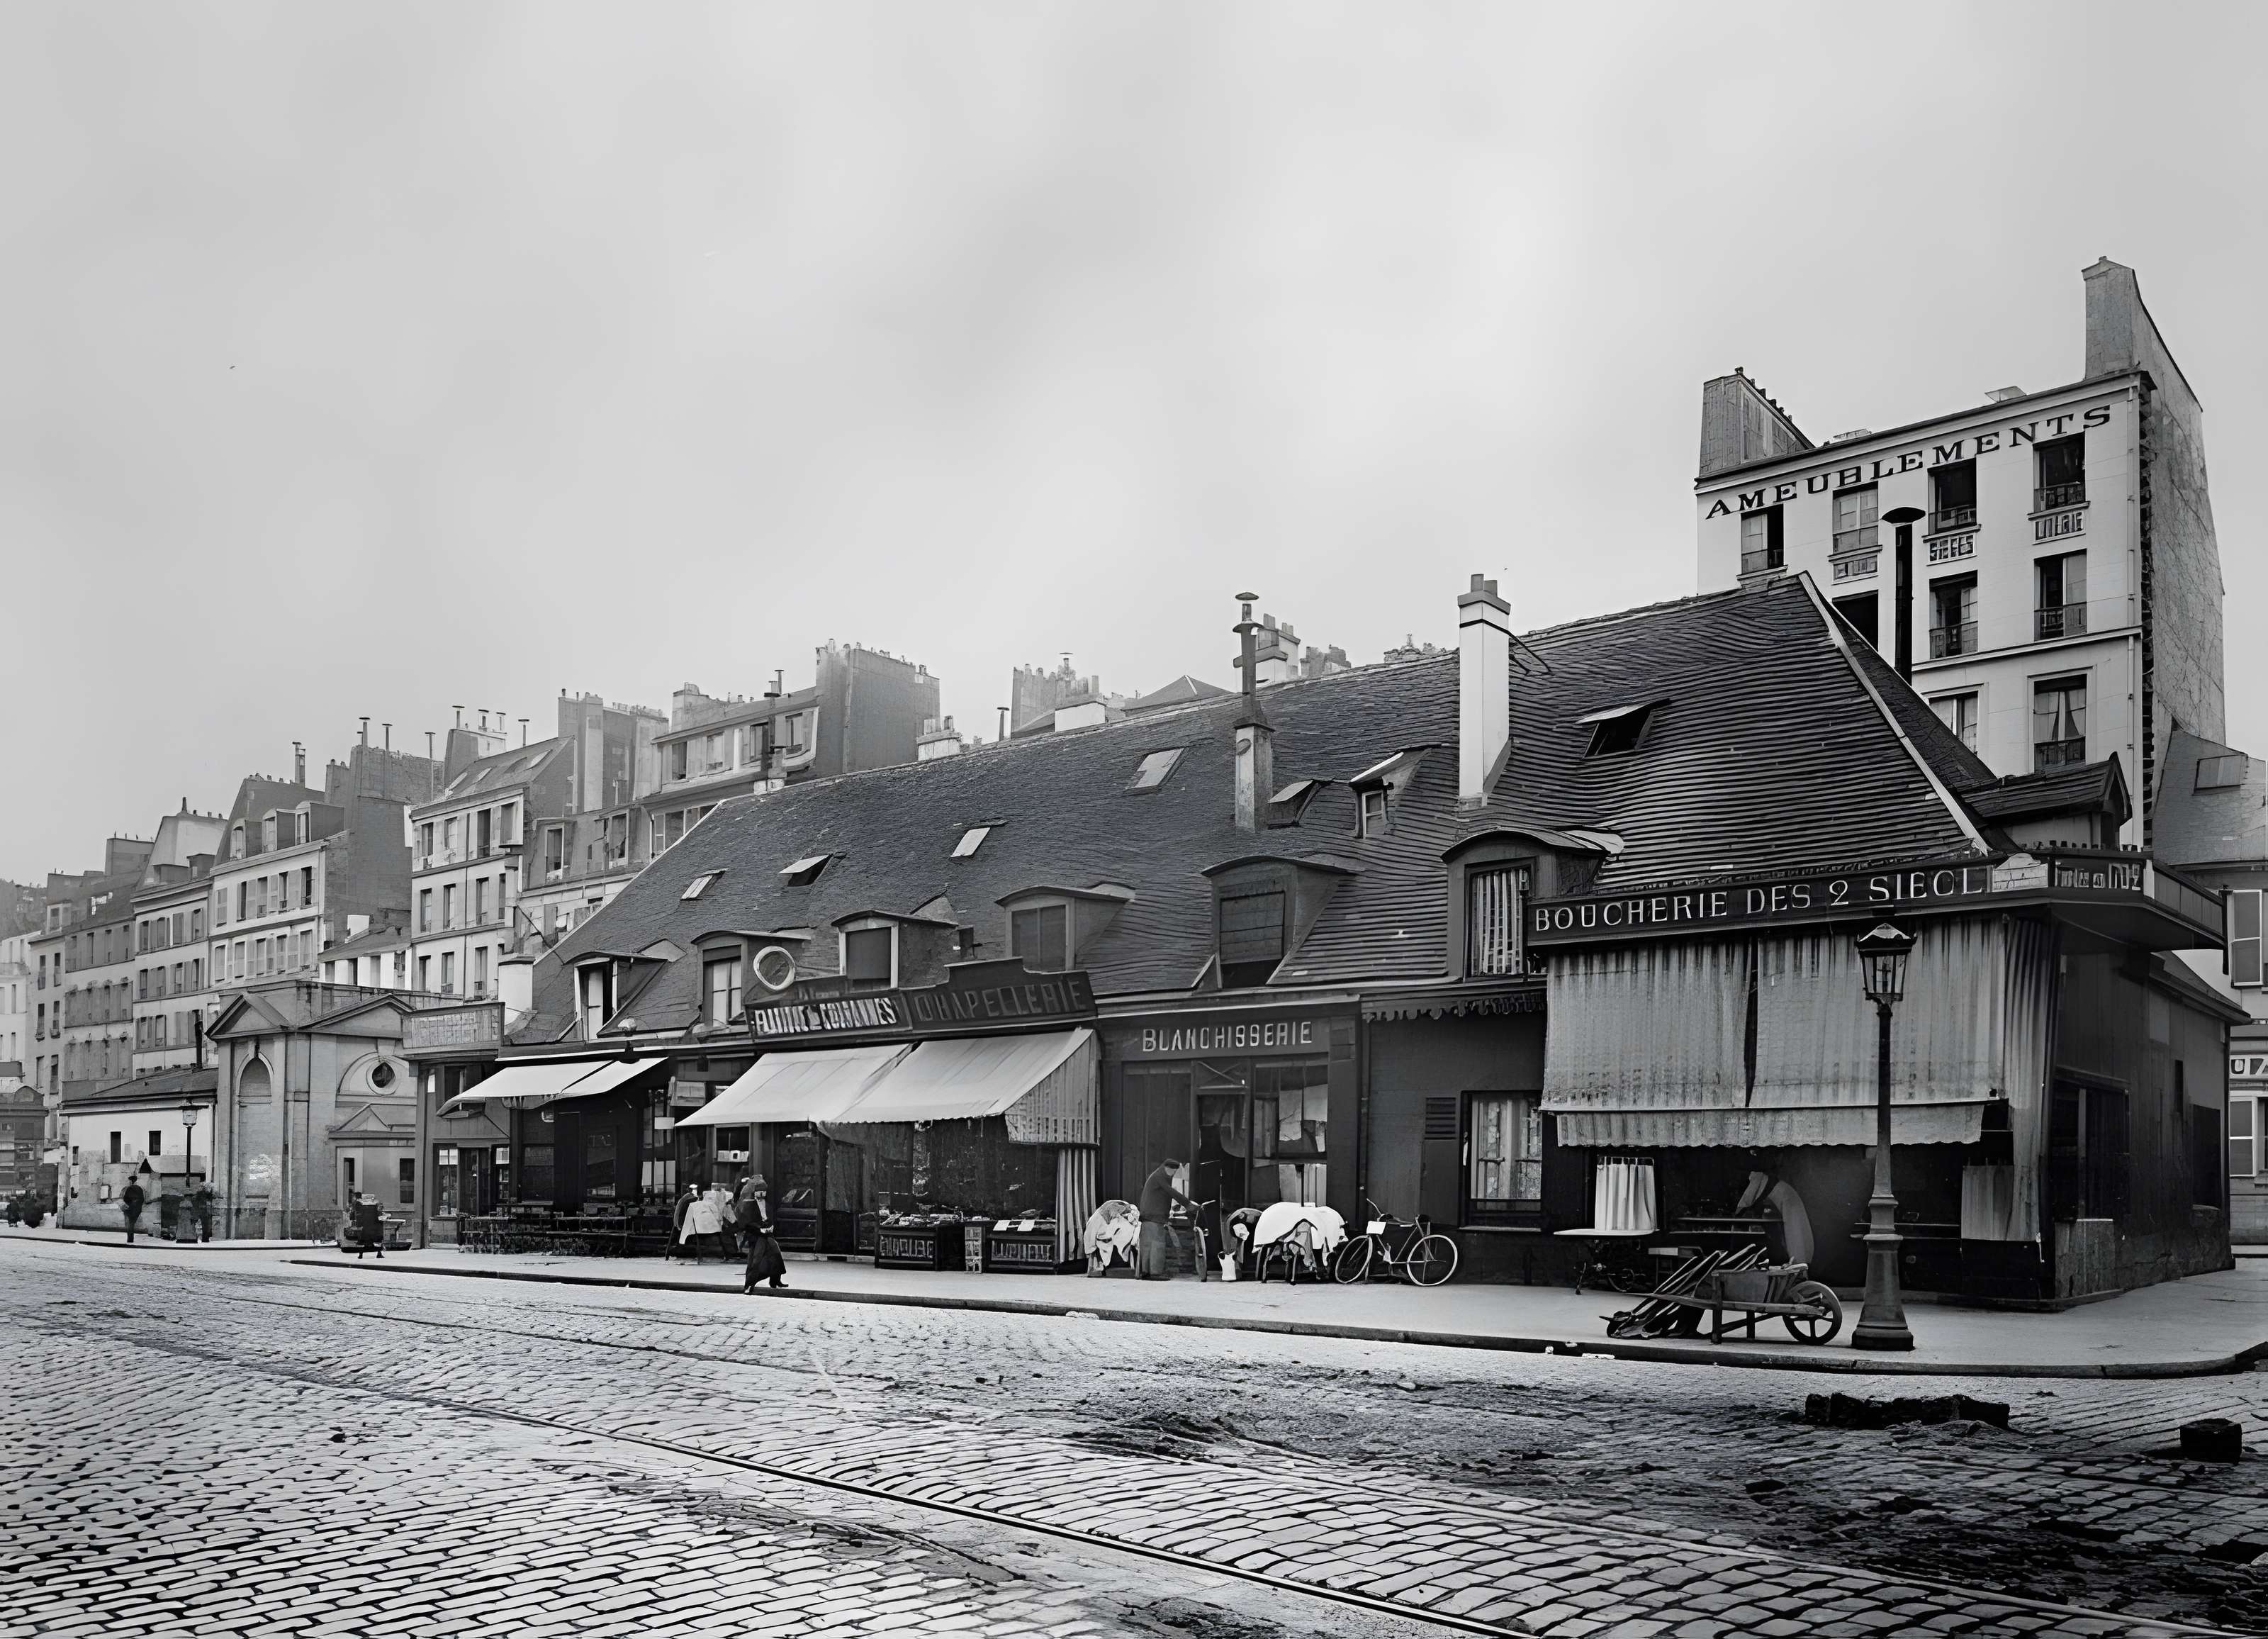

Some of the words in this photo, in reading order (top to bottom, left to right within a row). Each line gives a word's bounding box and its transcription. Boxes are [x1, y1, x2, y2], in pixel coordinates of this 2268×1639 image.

[1706, 404, 2111, 520] AMEUBLEMENTS
[1535, 891, 1728, 932] BOUCHERIE
[1746, 884, 1811, 914] DES
[1829, 880, 1849, 906] 2
[1142, 1021, 1313, 1052] BLANCHISSERIE
